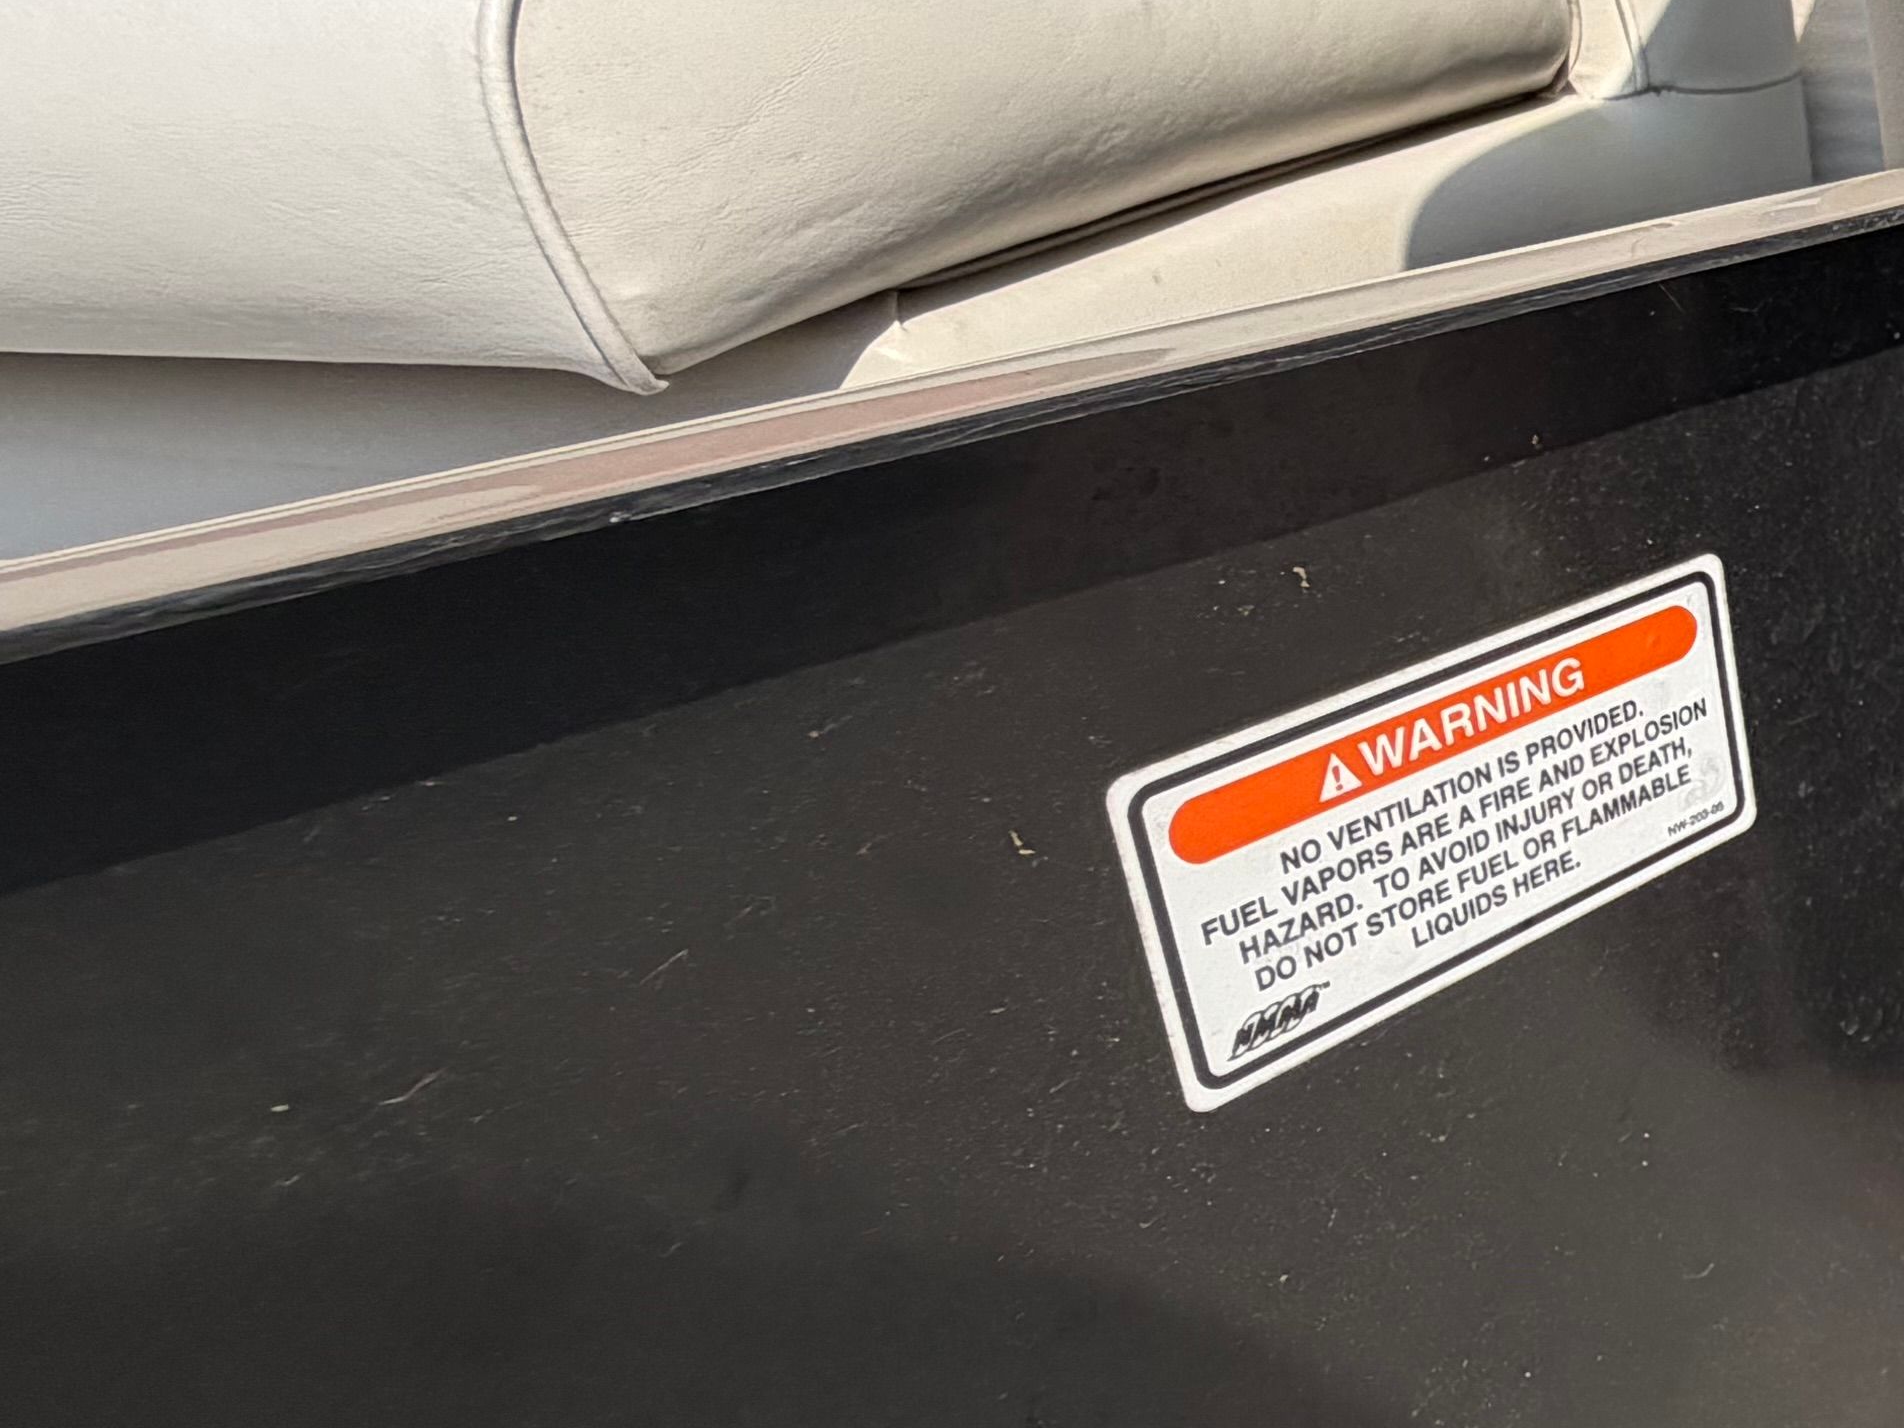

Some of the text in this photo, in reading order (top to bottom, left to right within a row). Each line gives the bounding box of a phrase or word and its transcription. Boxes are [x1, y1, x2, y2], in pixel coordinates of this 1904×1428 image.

[1280, 699, 1644, 874] NO VENTILATION IS PROVIDED.
[1357, 657, 1585, 776] WARNING
[1200, 697, 1707, 946] FUEL VAPORS ARE A FIRE AND EXPLOSION
[1239, 736, 1692, 965] HAZARD. TO AVOID INJURY OR DEATH,
[1255, 764, 1692, 992] DO NOT STORE FUEL OR FLAMMABLE
[1411, 850, 1581, 948] LIQUIDS HERE.
